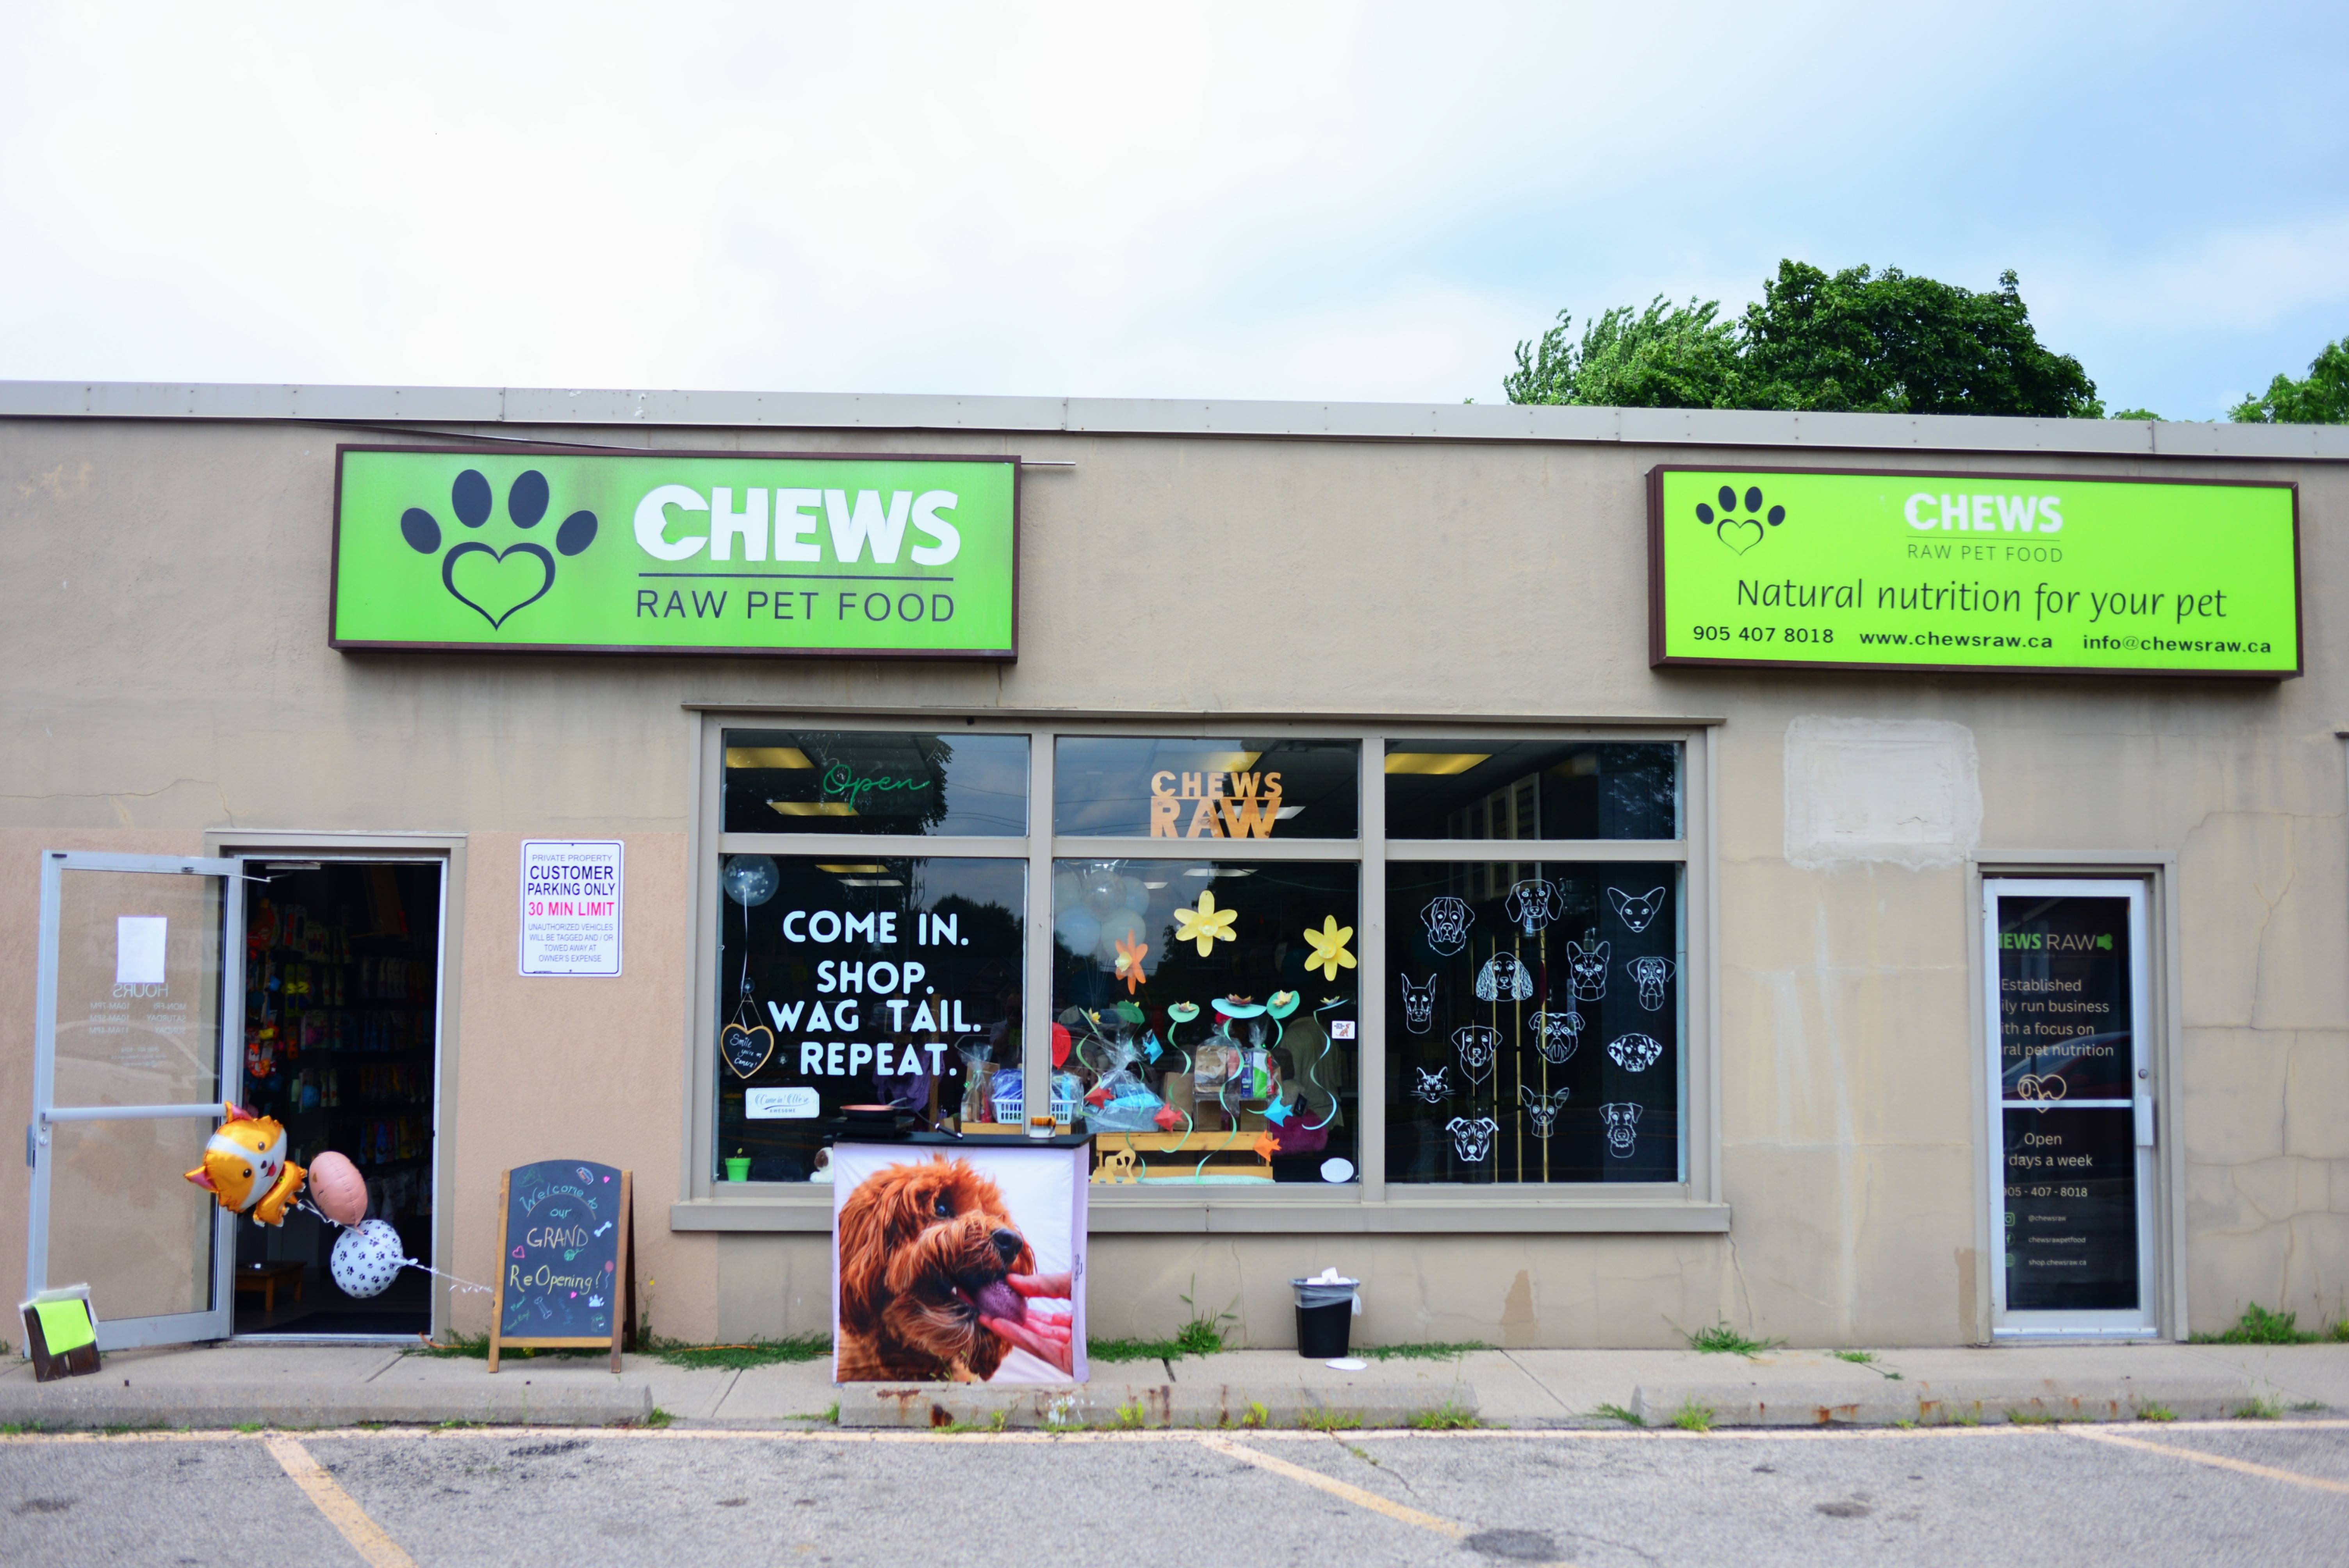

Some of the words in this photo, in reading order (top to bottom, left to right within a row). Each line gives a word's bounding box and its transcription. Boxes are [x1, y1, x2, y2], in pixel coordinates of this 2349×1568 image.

[1904, 492, 2063, 533] CHEWS
[634, 485, 960, 565] CHEWS
[1908, 544, 1951, 559] RAW
[1962, 545, 1996, 560] PET
[2007, 547, 2062, 562] FOOD
[637, 589, 727, 618] RAW
[747, 591, 818, 620] PET
[838, 592, 955, 622] FOOD
[1738, 579, 1862, 608] Natural
[1879, 581, 2020, 611] nutrition
[2035, 583, 2080, 621] for
[2090, 593, 2164, 622] your
[2177, 590, 2226, 624] pet
[1693, 626, 1730, 640] 905
[1739, 627, 1775, 641] 407
[1784, 628, 1833, 643] 8018
[1860, 631, 2052, 648] www.chewsraw.ca
[2084, 635, 2271, 653] info@chewsraw.ca
[823, 763, 930, 813] Open
[1151, 771, 1282, 798] CHEWS
[1150, 796, 1282, 838] RAW
[530, 866, 613, 879] CUSTOMER
[528, 883, 580, 895] PARKING
[584, 883, 615, 895] ONLY
[529, 902, 543, 916] 30
[548, 902, 573, 916] MIN
[579, 902, 614, 916] LIMIT
[783, 911, 896, 943] COME
[919, 913, 969, 946] IN.
[2047, 934, 2096, 950] RAW
[817, 960, 934, 994] SHOP.
[2001, 979, 2081, 991] Established
[2021, 1001, 2044, 1012] run
[2049, 1000, 2109, 1012] business
[768, 999, 858, 1032] WAG
[886, 1000, 981, 1032] TAIL.
[2023, 1025, 2031, 1034] a
[2035, 1022, 2073, 1035] focus
[2077, 1025, 2094, 1035] on
[730, 1033, 752, 1048] Smile
[800, 1042, 957, 1076] REPEAT.
[2025, 1046, 2048, 1058] pet
[2053, 1044, 2114, 1056] nutrition
[2024, 1133, 2062, 1148] Open
[2009, 1154, 2042, 1169] days
[2046, 1156, 2054, 1166] a
[2057, 1155, 2093, 1166] week
[520, 1184, 584, 1211] Welcome
[588, 1197, 597, 1209] to
[2031, 1187, 2051, 1196] 407
[2060, 1188, 2087, 1197] 8018
[550, 1208, 572, 1219] our
[526, 1224, 588, 1249] GRAND
